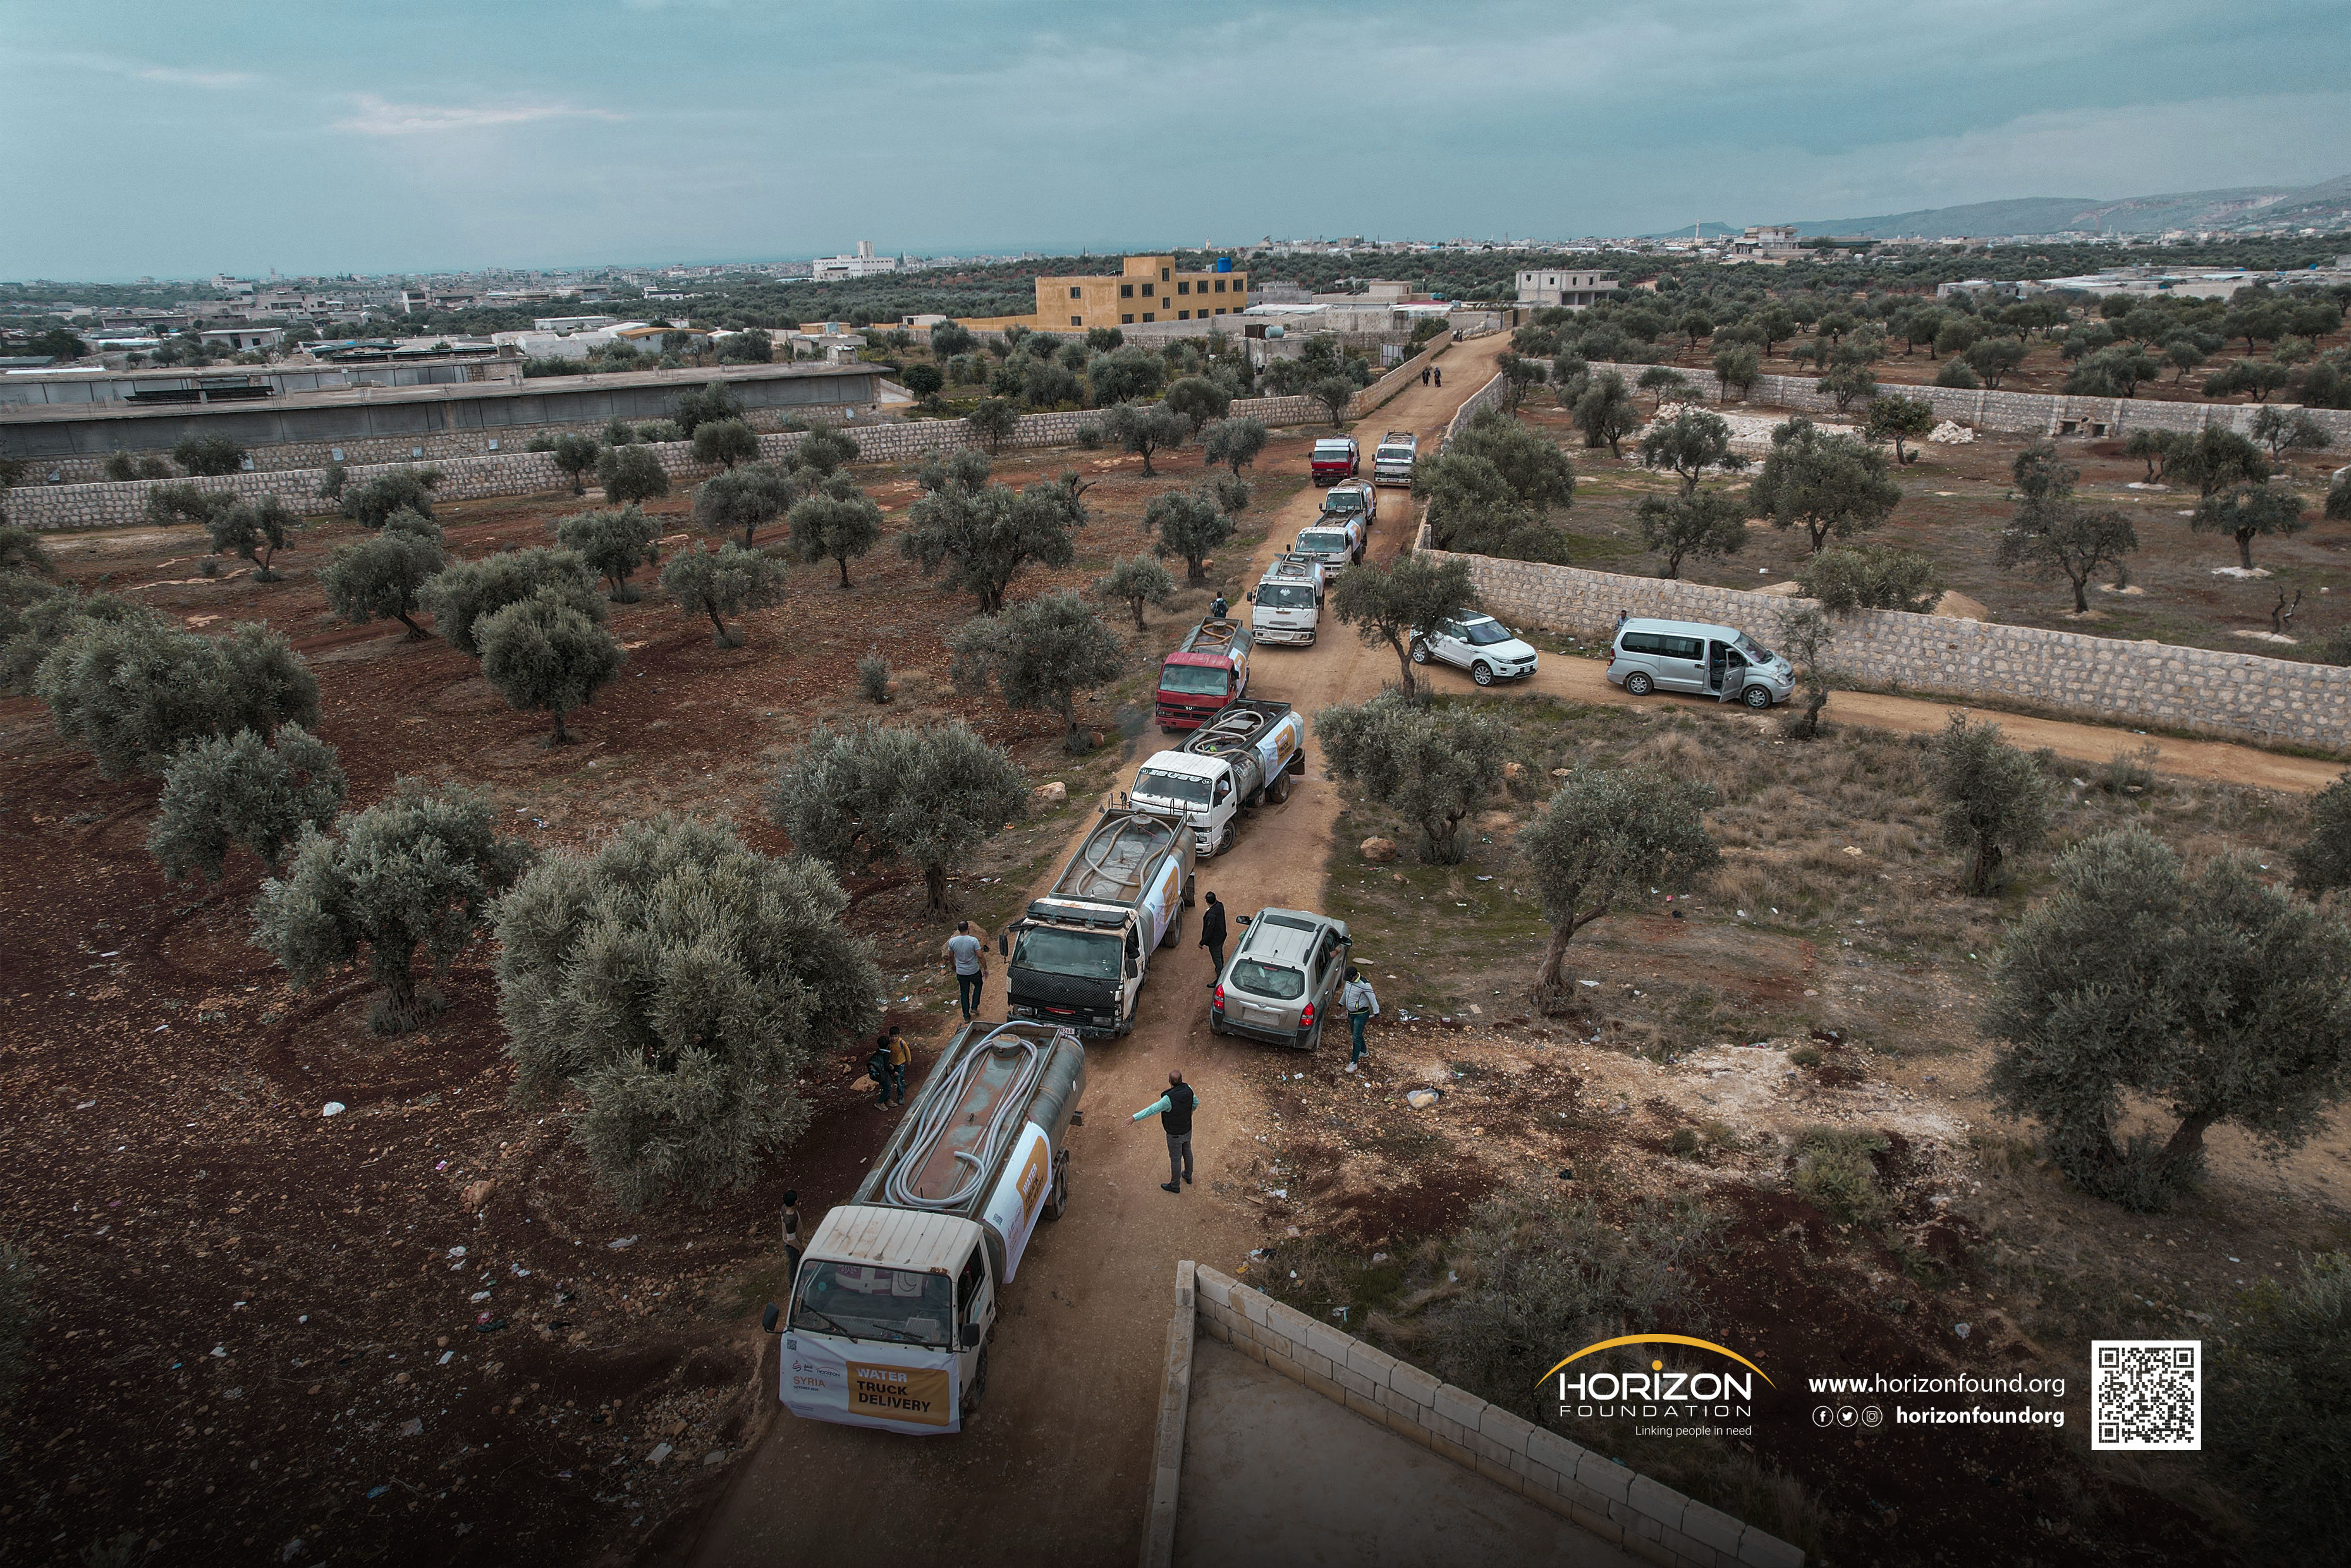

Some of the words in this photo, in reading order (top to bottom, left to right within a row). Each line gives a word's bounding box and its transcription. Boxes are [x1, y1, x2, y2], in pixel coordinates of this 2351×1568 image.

[1149, 769, 1202, 782] ISUZU
[1022, 1162, 1038, 1195] WATER
[1025, 1175, 1039, 1205] TRUCK
[817, 1368, 840, 1377] HORIZON
[856, 1368, 908, 1383] WATER
[793, 1376, 825, 1388] SYRIA
[857, 1380, 908, 1396] TRUCK
[859, 1392, 931, 1412] DELIVERY
